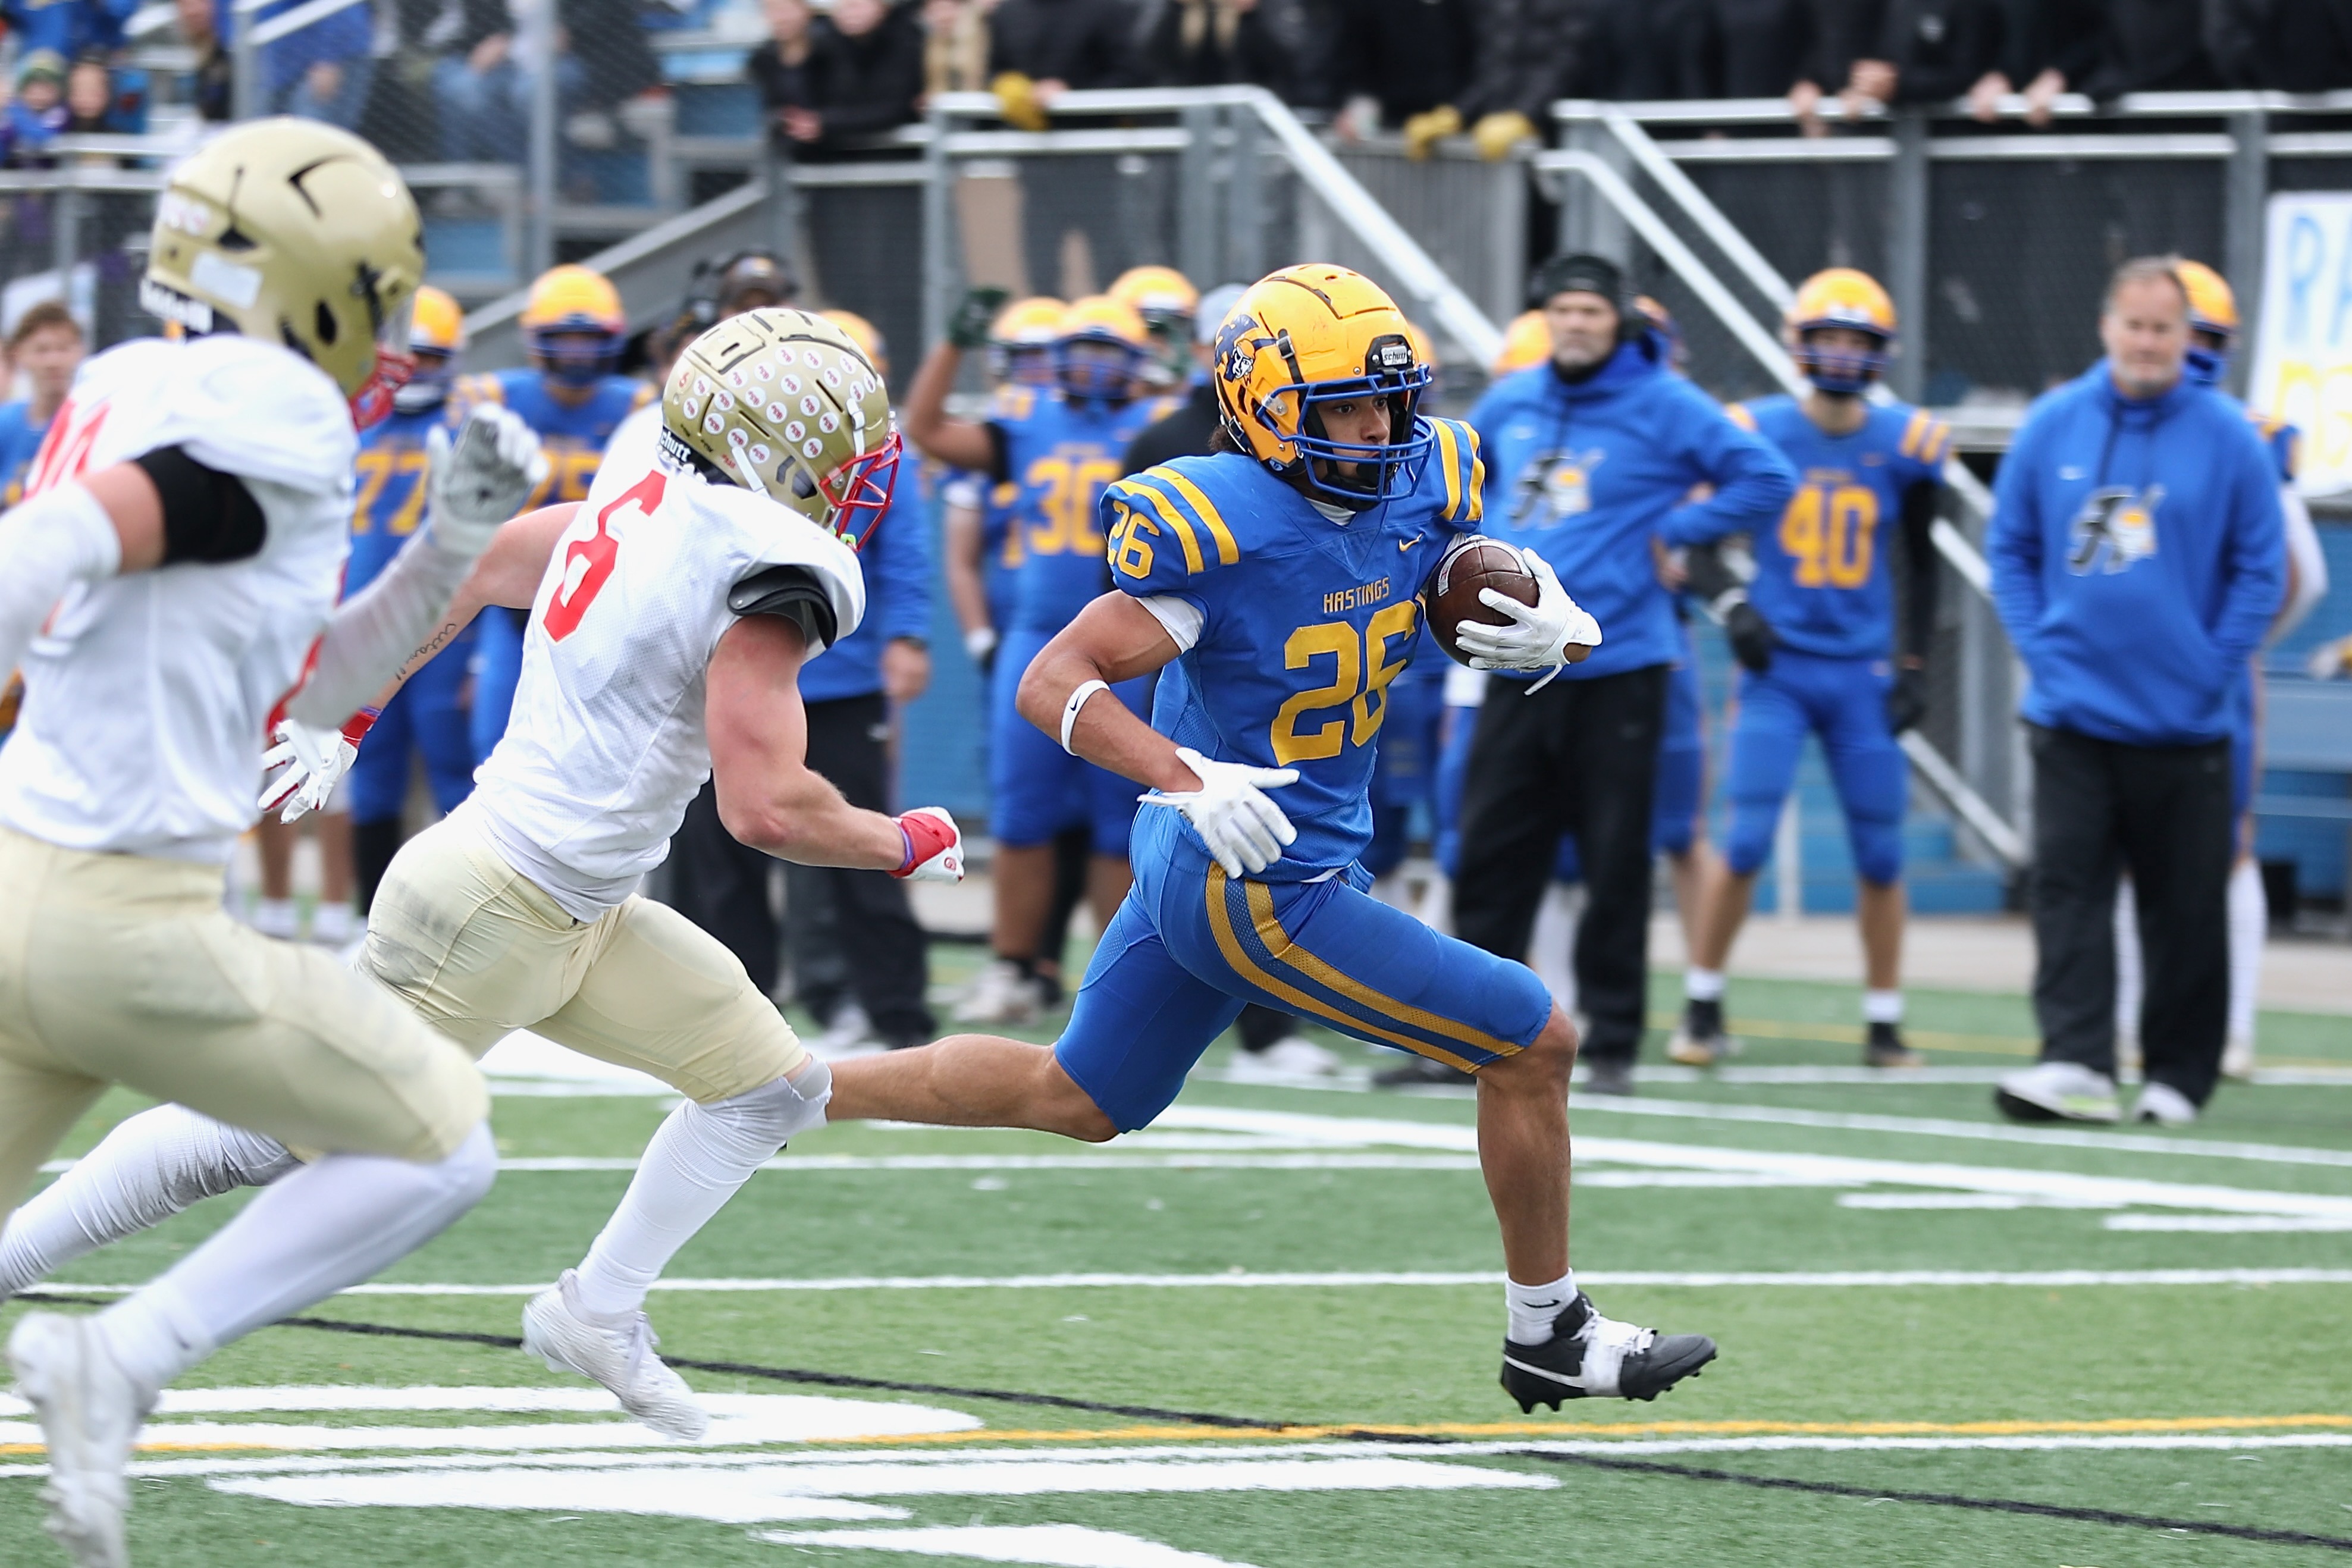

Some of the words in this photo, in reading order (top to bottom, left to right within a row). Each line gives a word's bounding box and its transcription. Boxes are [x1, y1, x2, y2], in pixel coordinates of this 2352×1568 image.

[1384, 350, 1406, 361] schutt
[659, 430, 691, 462] chutt
[542, 469, 667, 643] 6
[1106, 500, 1161, 579] 26
[1777, 486, 1879, 588] 40
[1323, 576, 1390, 614] HASTINGS
[1270, 599, 1418, 767] 26
